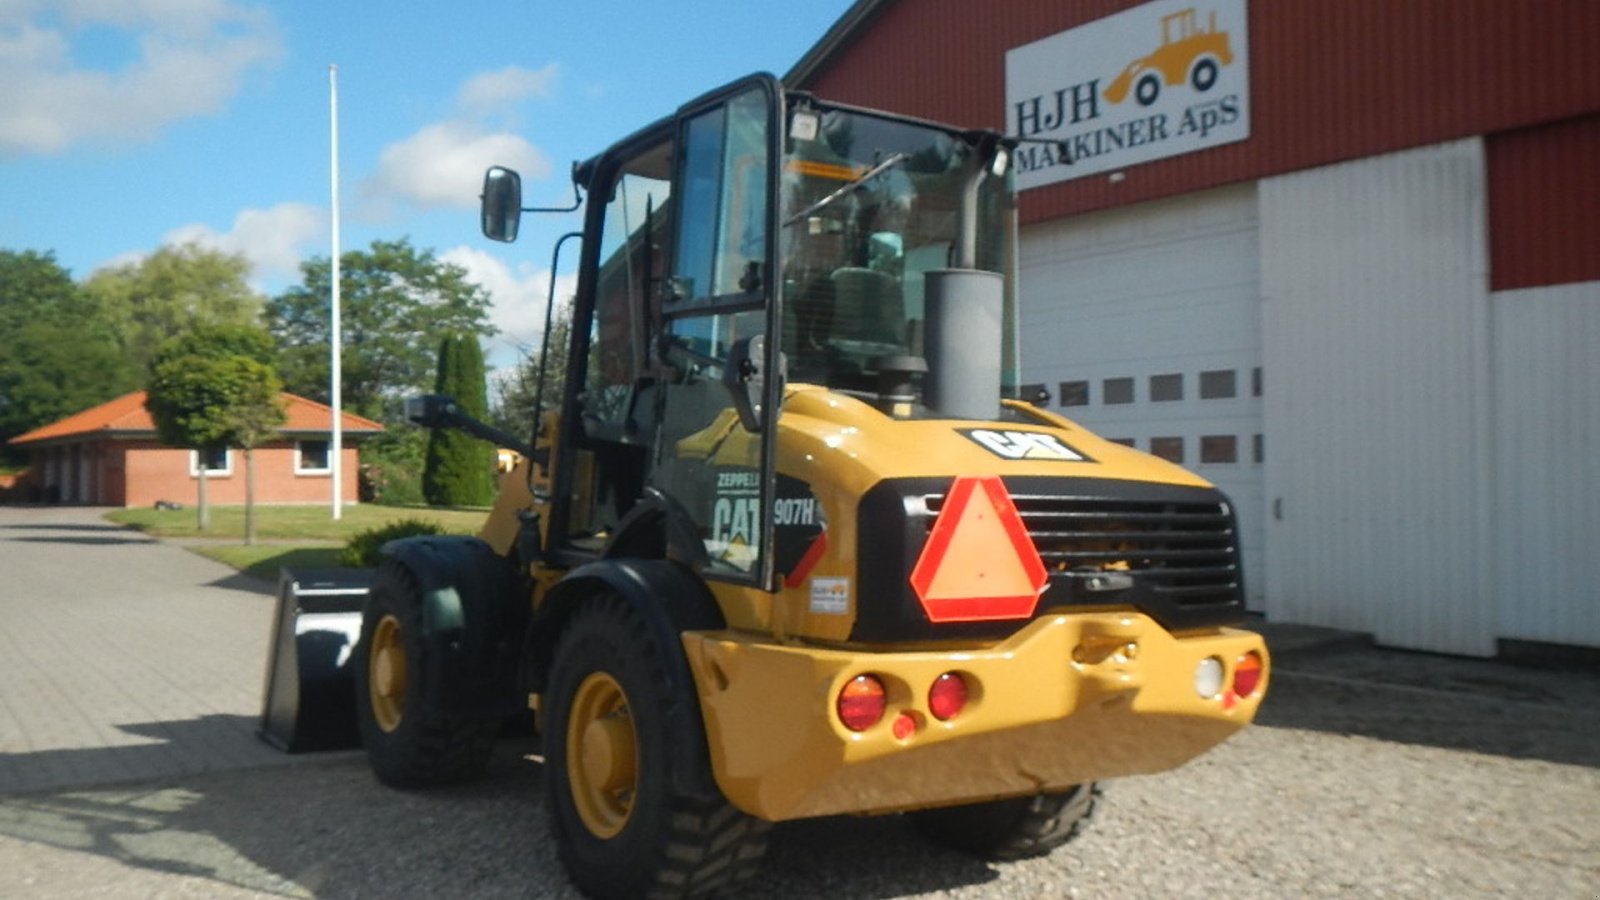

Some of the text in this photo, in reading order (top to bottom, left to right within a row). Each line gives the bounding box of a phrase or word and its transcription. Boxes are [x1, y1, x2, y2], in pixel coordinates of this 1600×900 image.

[1014, 78, 1101, 138] HJH
[1016, 94, 1240, 174] MAKINER ApS
[970, 429, 1084, 460] CAT
[712, 498, 760, 560] CAT
[773, 498, 815, 525] 907H
